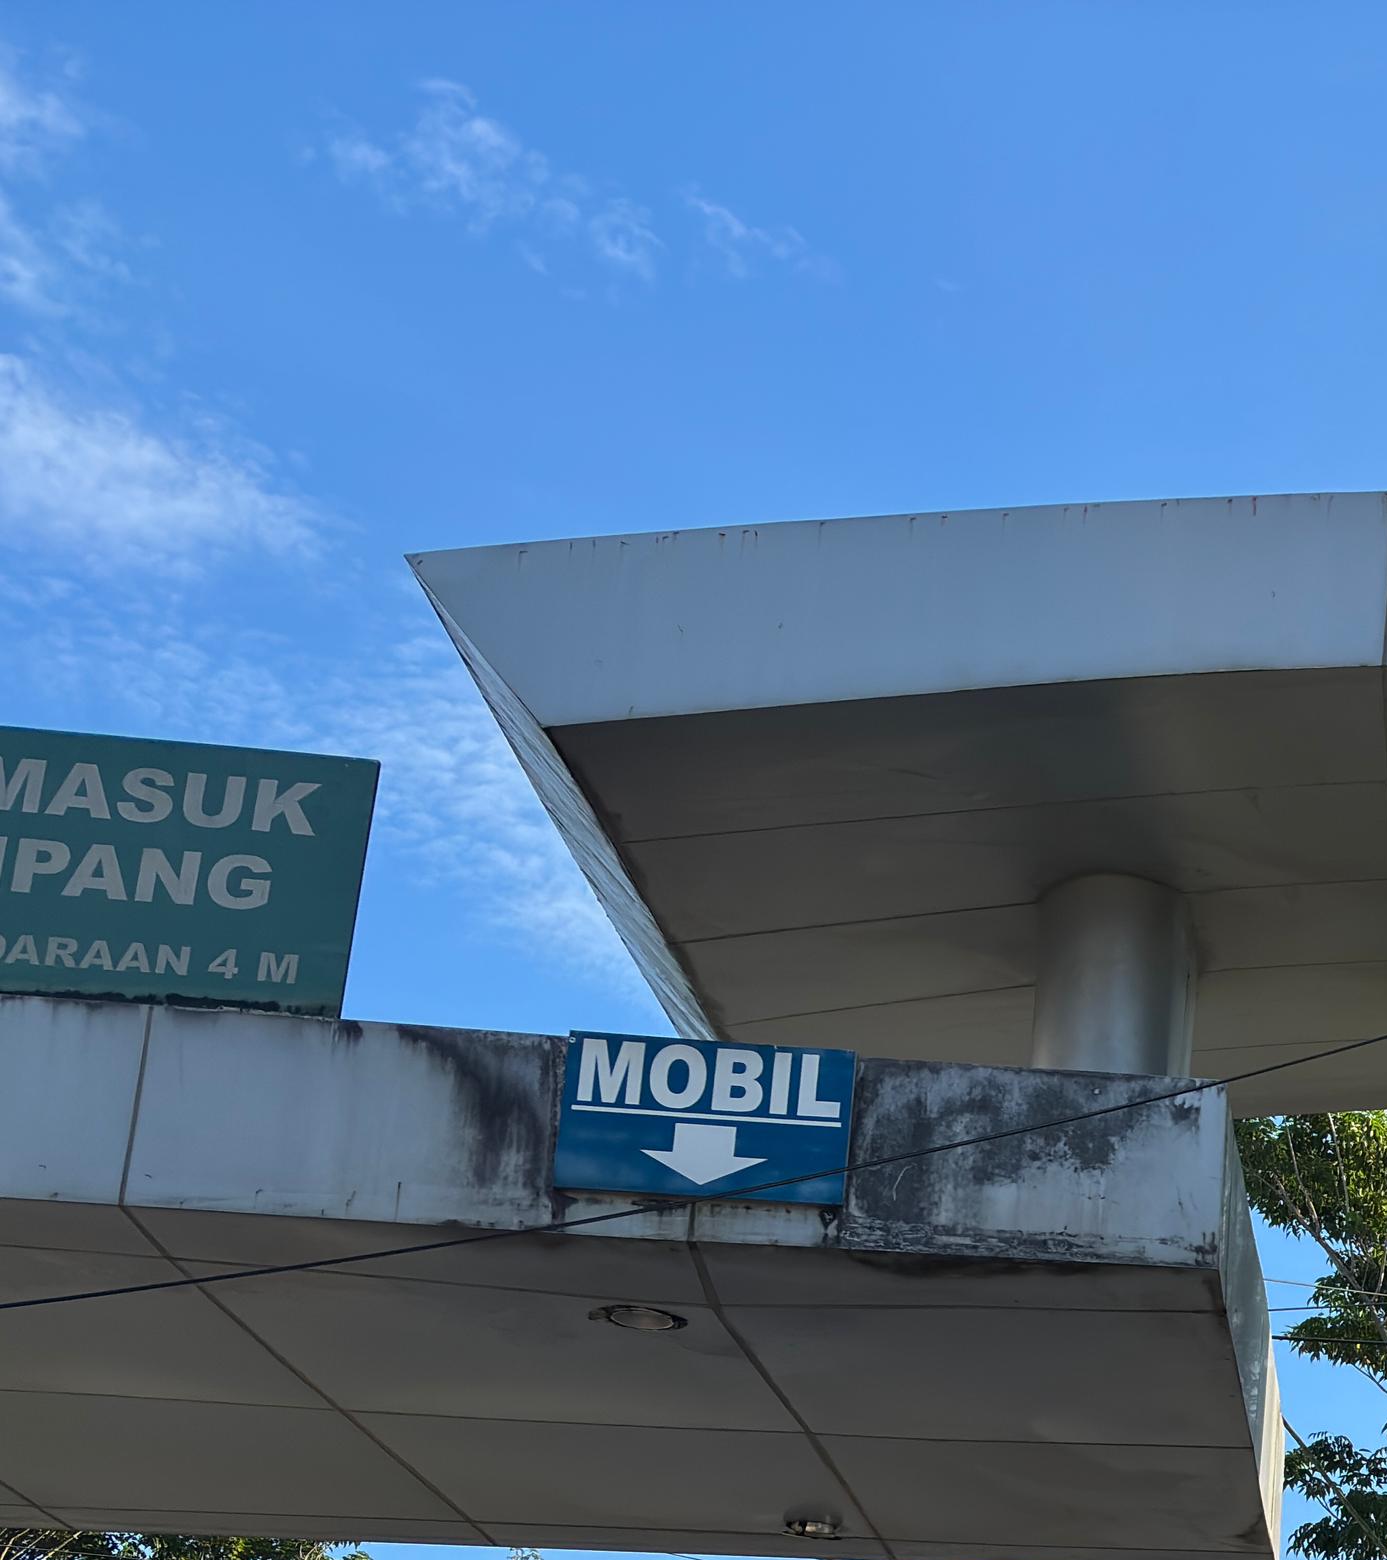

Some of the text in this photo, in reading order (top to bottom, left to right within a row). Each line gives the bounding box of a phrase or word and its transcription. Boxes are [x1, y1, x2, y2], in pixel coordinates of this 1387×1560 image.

[0, 755, 322, 837] MASUK
[0, 836, 273, 910] PANG
[0, 933, 300, 984] ARAAN 4 M
[576, 1038, 842, 1119] MOBIL
